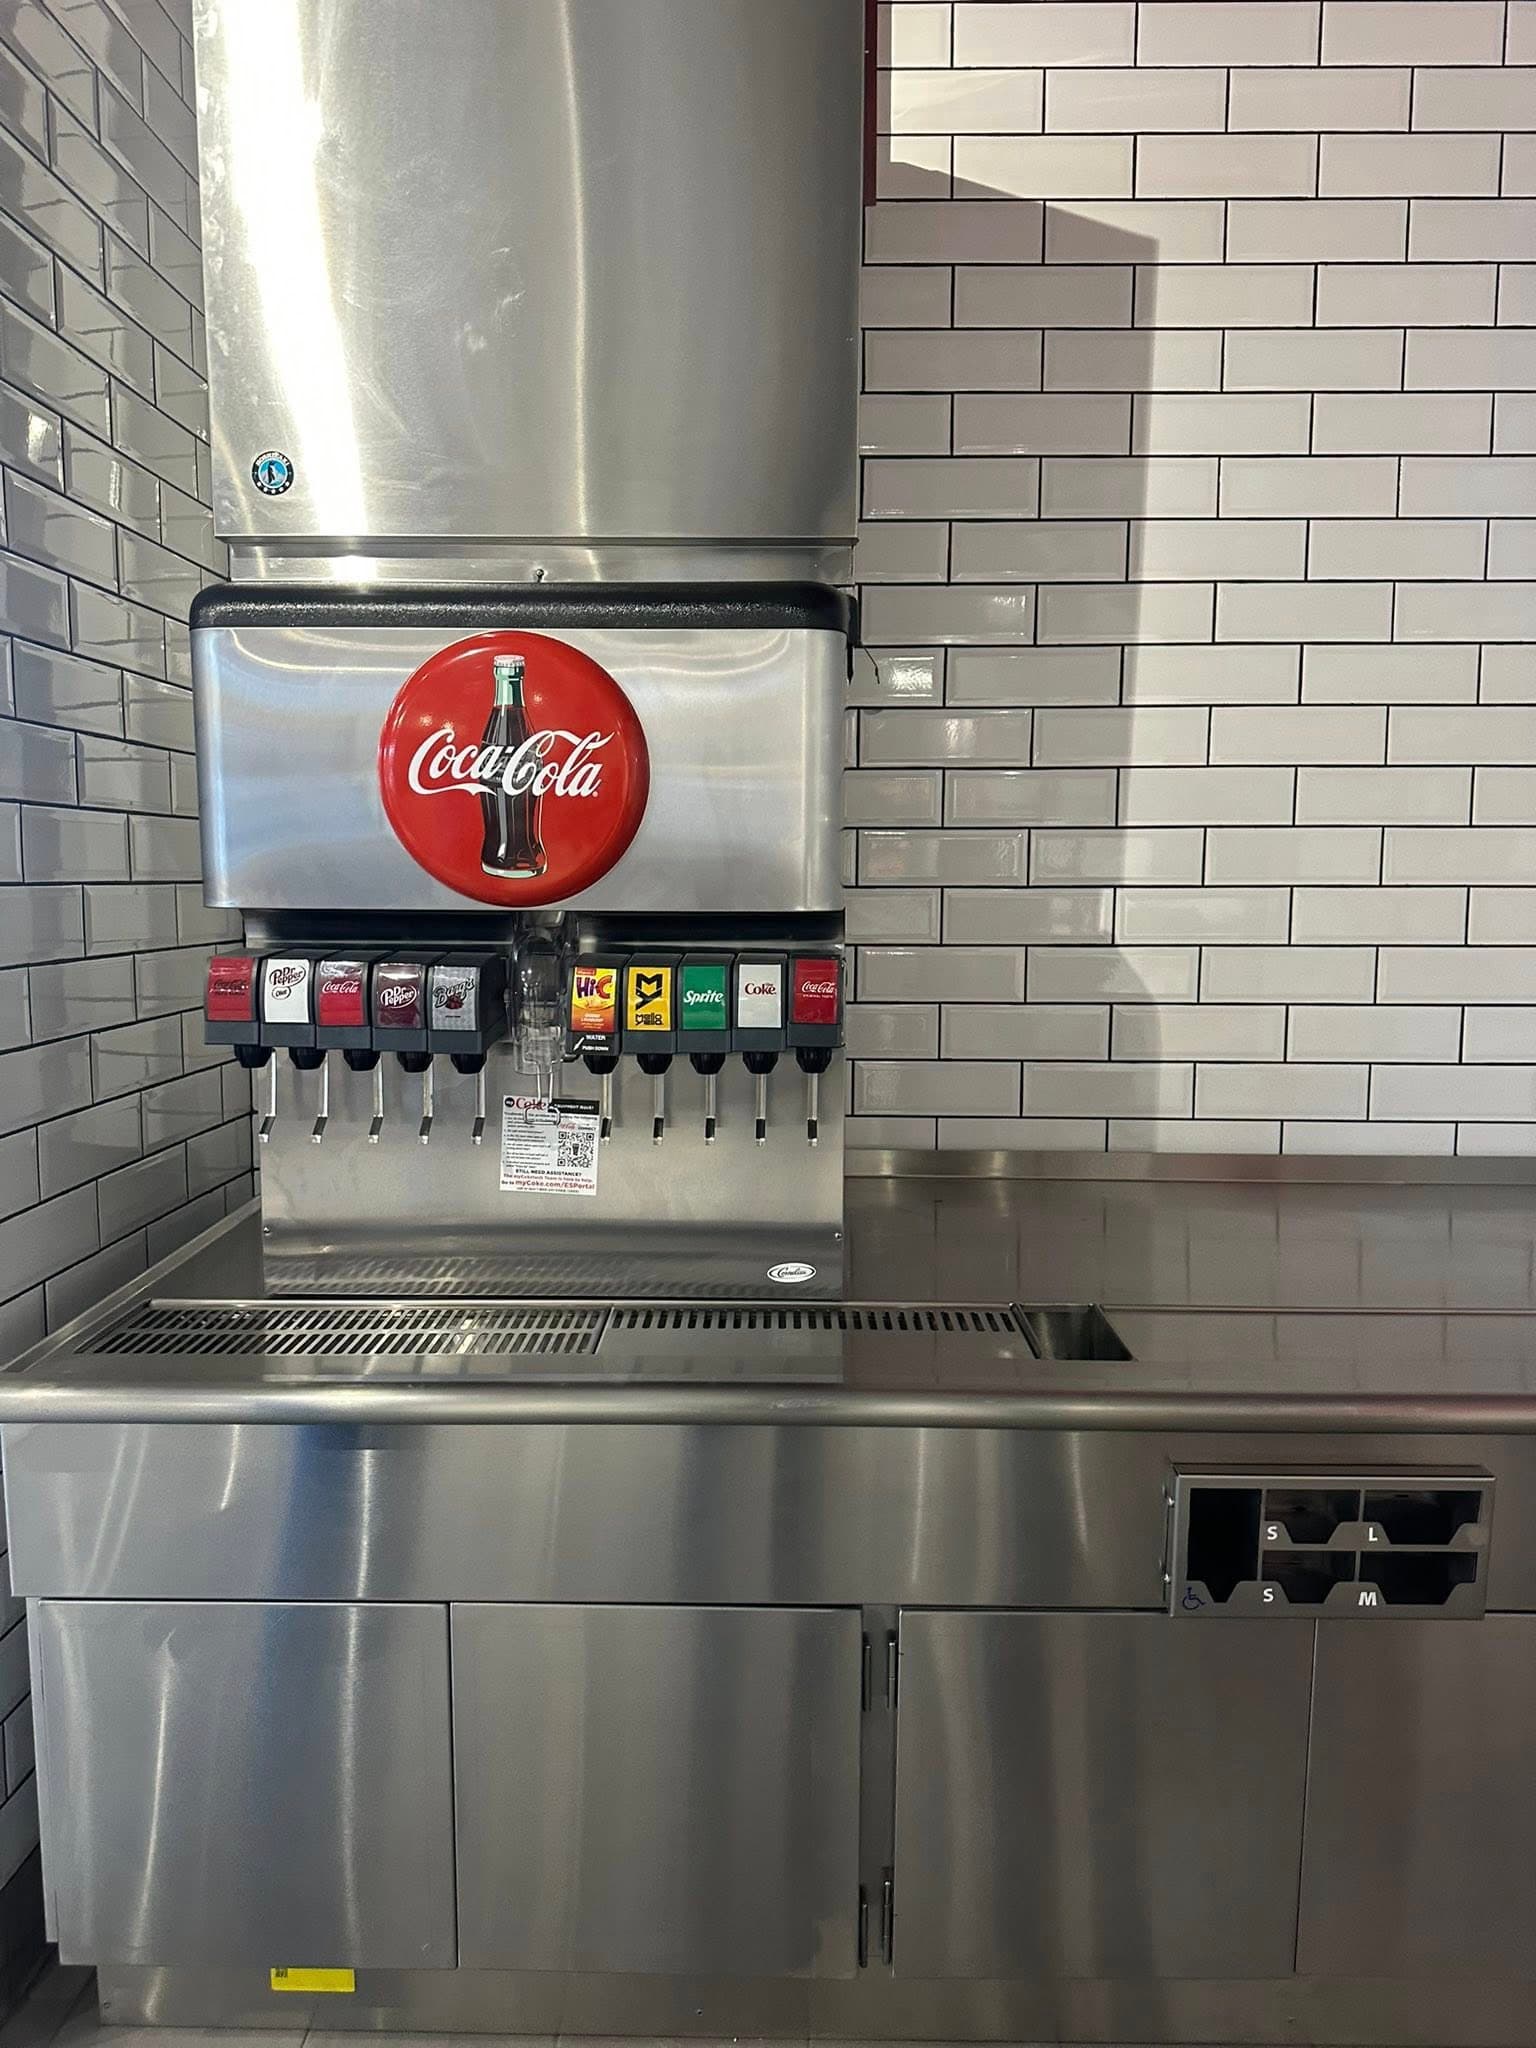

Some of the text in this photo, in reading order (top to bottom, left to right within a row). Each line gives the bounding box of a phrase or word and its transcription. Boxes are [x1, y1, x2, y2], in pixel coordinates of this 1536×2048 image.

[408, 728, 616, 798] Coca-Cola
[384, 988, 414, 1006] Pepper
[745, 982, 776, 995] Coke
[683, 989, 724, 1006] Sprite
[1266, 1526, 1378, 1542] S L
[1263, 1588, 1377, 1606] S M
